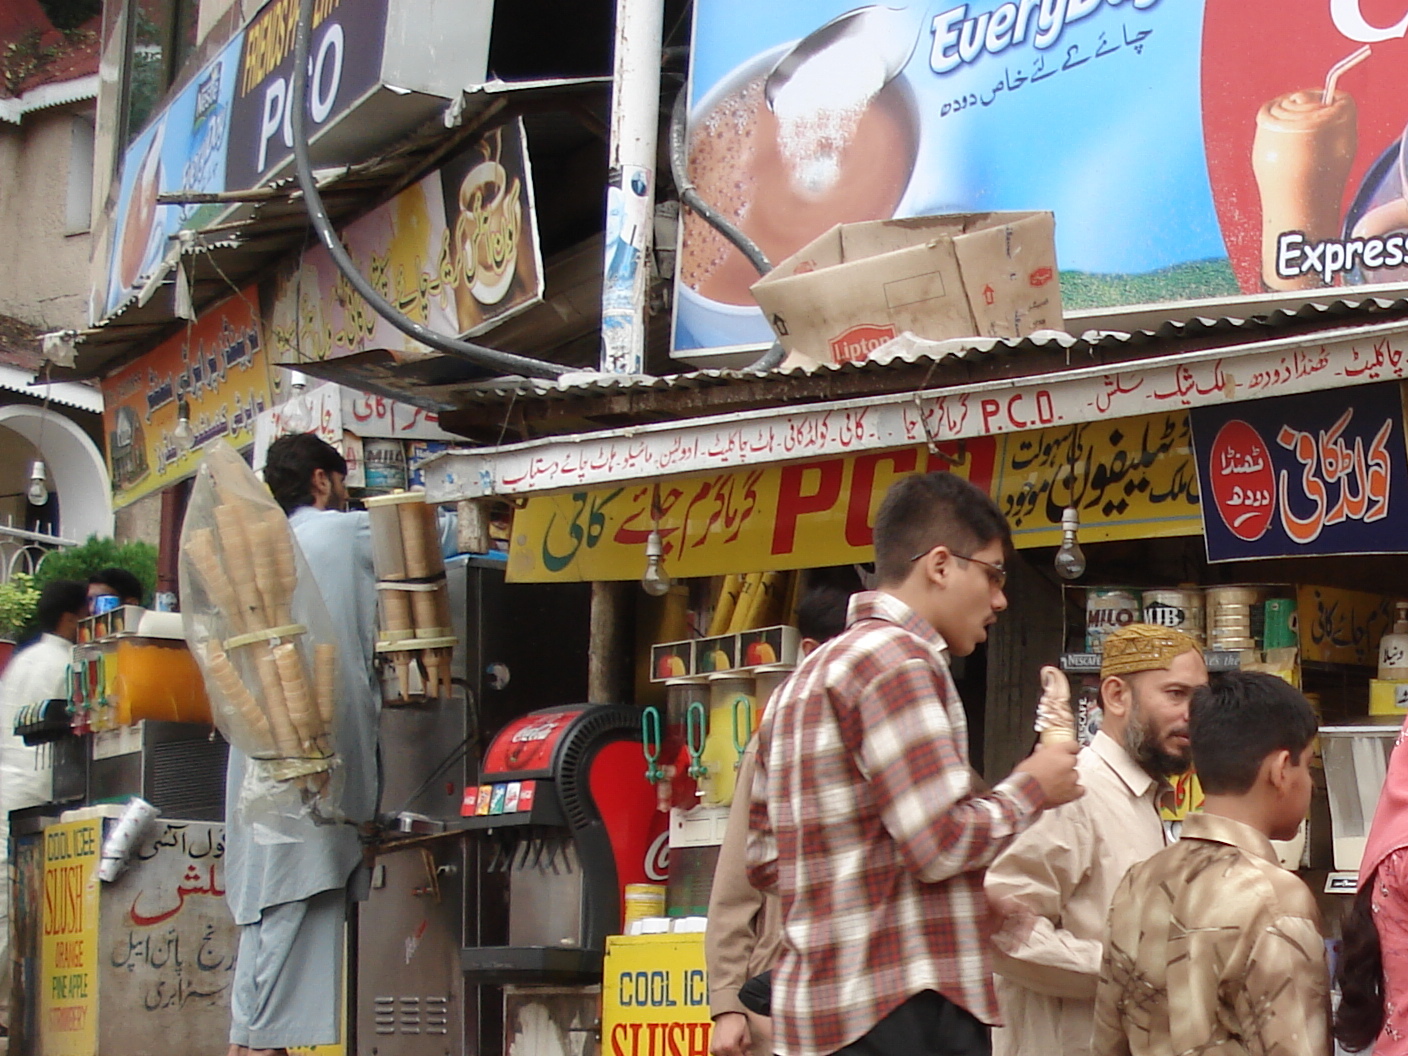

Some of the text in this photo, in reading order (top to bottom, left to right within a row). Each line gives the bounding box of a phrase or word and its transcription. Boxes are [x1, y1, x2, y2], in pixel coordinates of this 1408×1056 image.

[1062, 44, 1093, 71] کے
[1095, 23, 1153, 57] چائے
[980, 67, 1029, 107] خاص
[1221, 445, 1264, 476] ٹھنڈا
[1276, 407, 1354, 544] کافی
[1324, 418, 1393, 526] کولڈ
[1225, 485, 1270, 508] دودھ
[1088, 608, 1133, 628] MILO
[44, 864, 84, 936] SLUSH
[619, 970, 709, 1007] COOL IC
